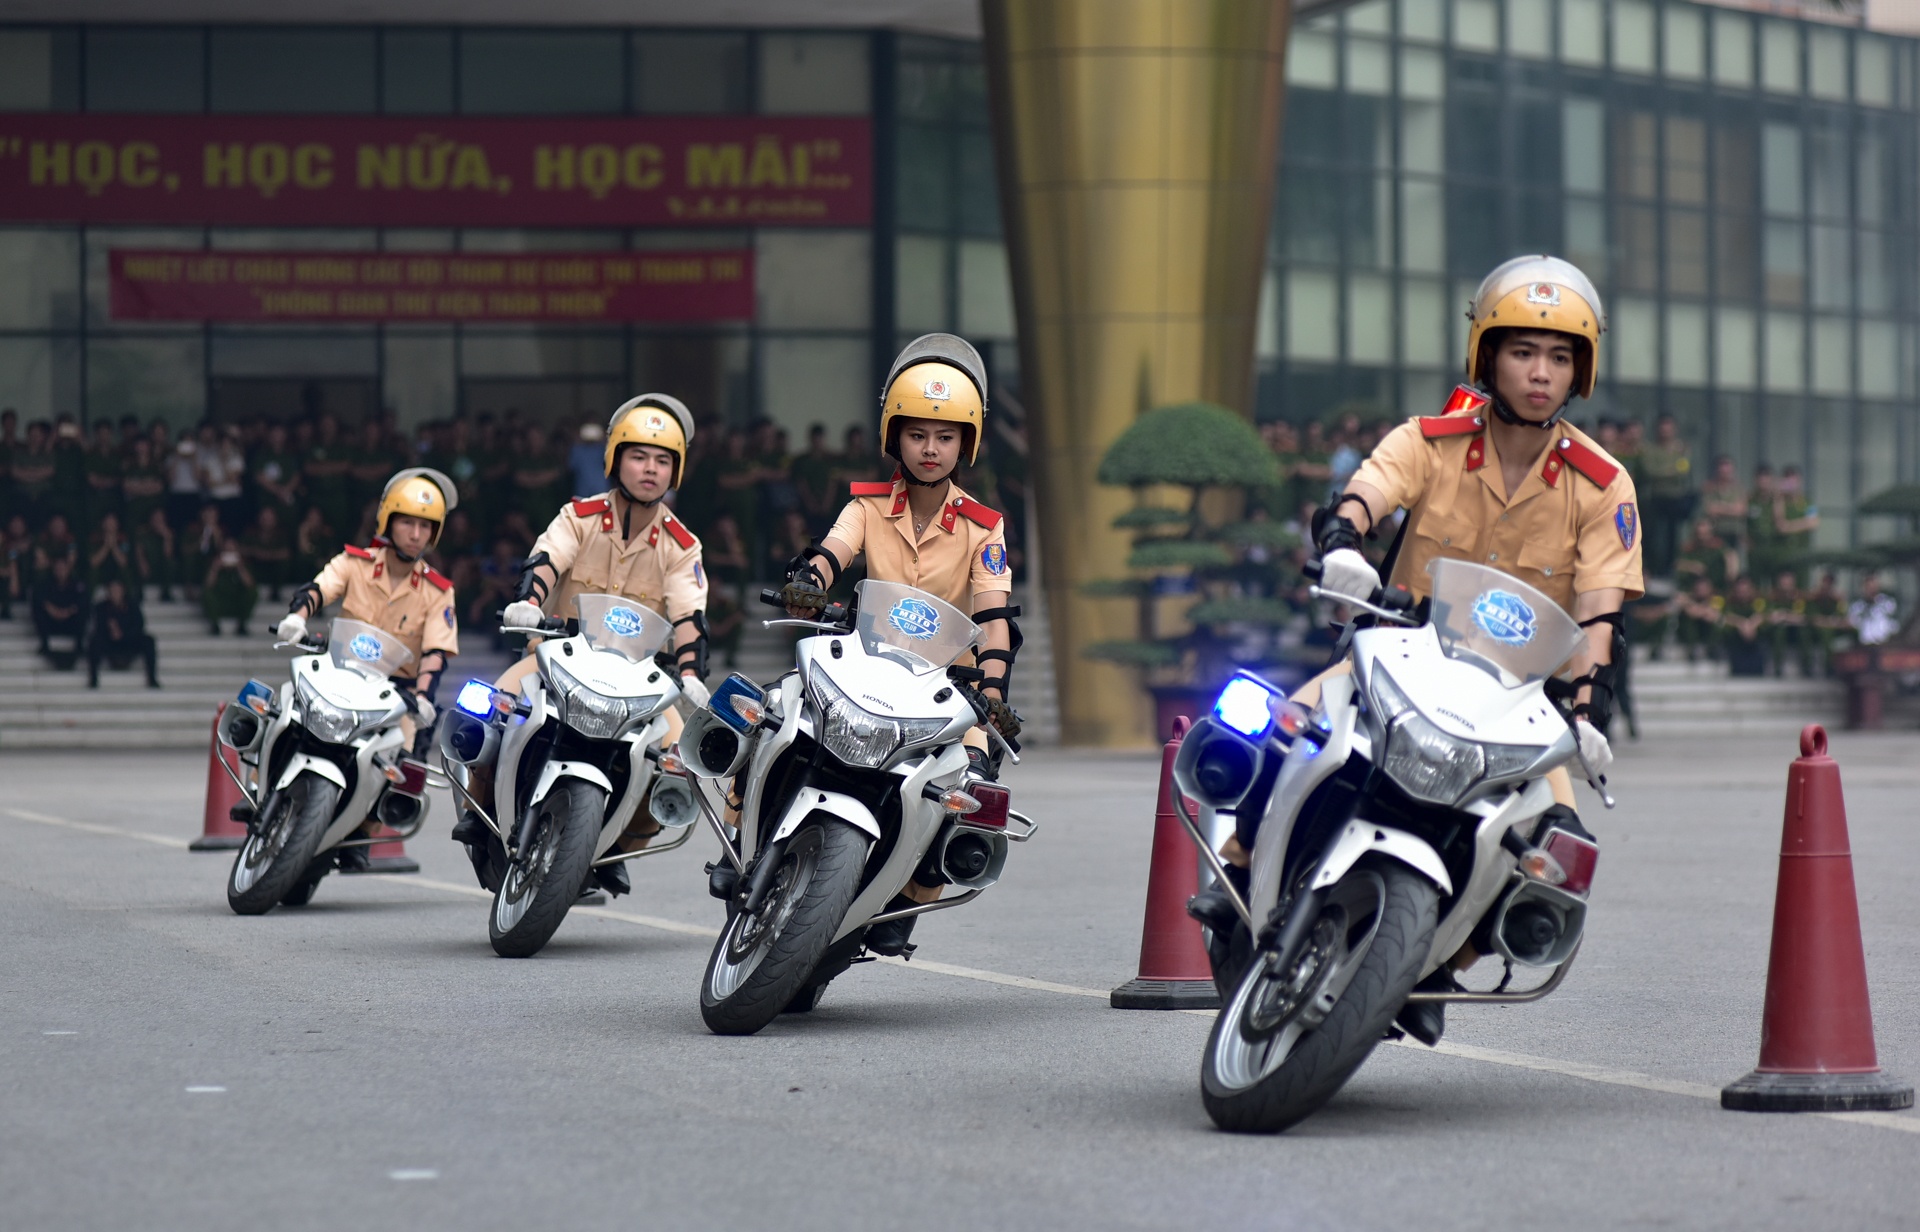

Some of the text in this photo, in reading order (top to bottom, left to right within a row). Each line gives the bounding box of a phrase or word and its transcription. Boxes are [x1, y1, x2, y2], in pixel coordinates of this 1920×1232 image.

[203, 141, 335, 197] HỌC
[535, 142, 664, 199] HỌC
[899, 610, 931, 628] MOTO
[1485, 604, 1526, 632] MOTO
[862, 693, 895, 711] HONDA
[1436, 707, 1476, 731] HONDA
